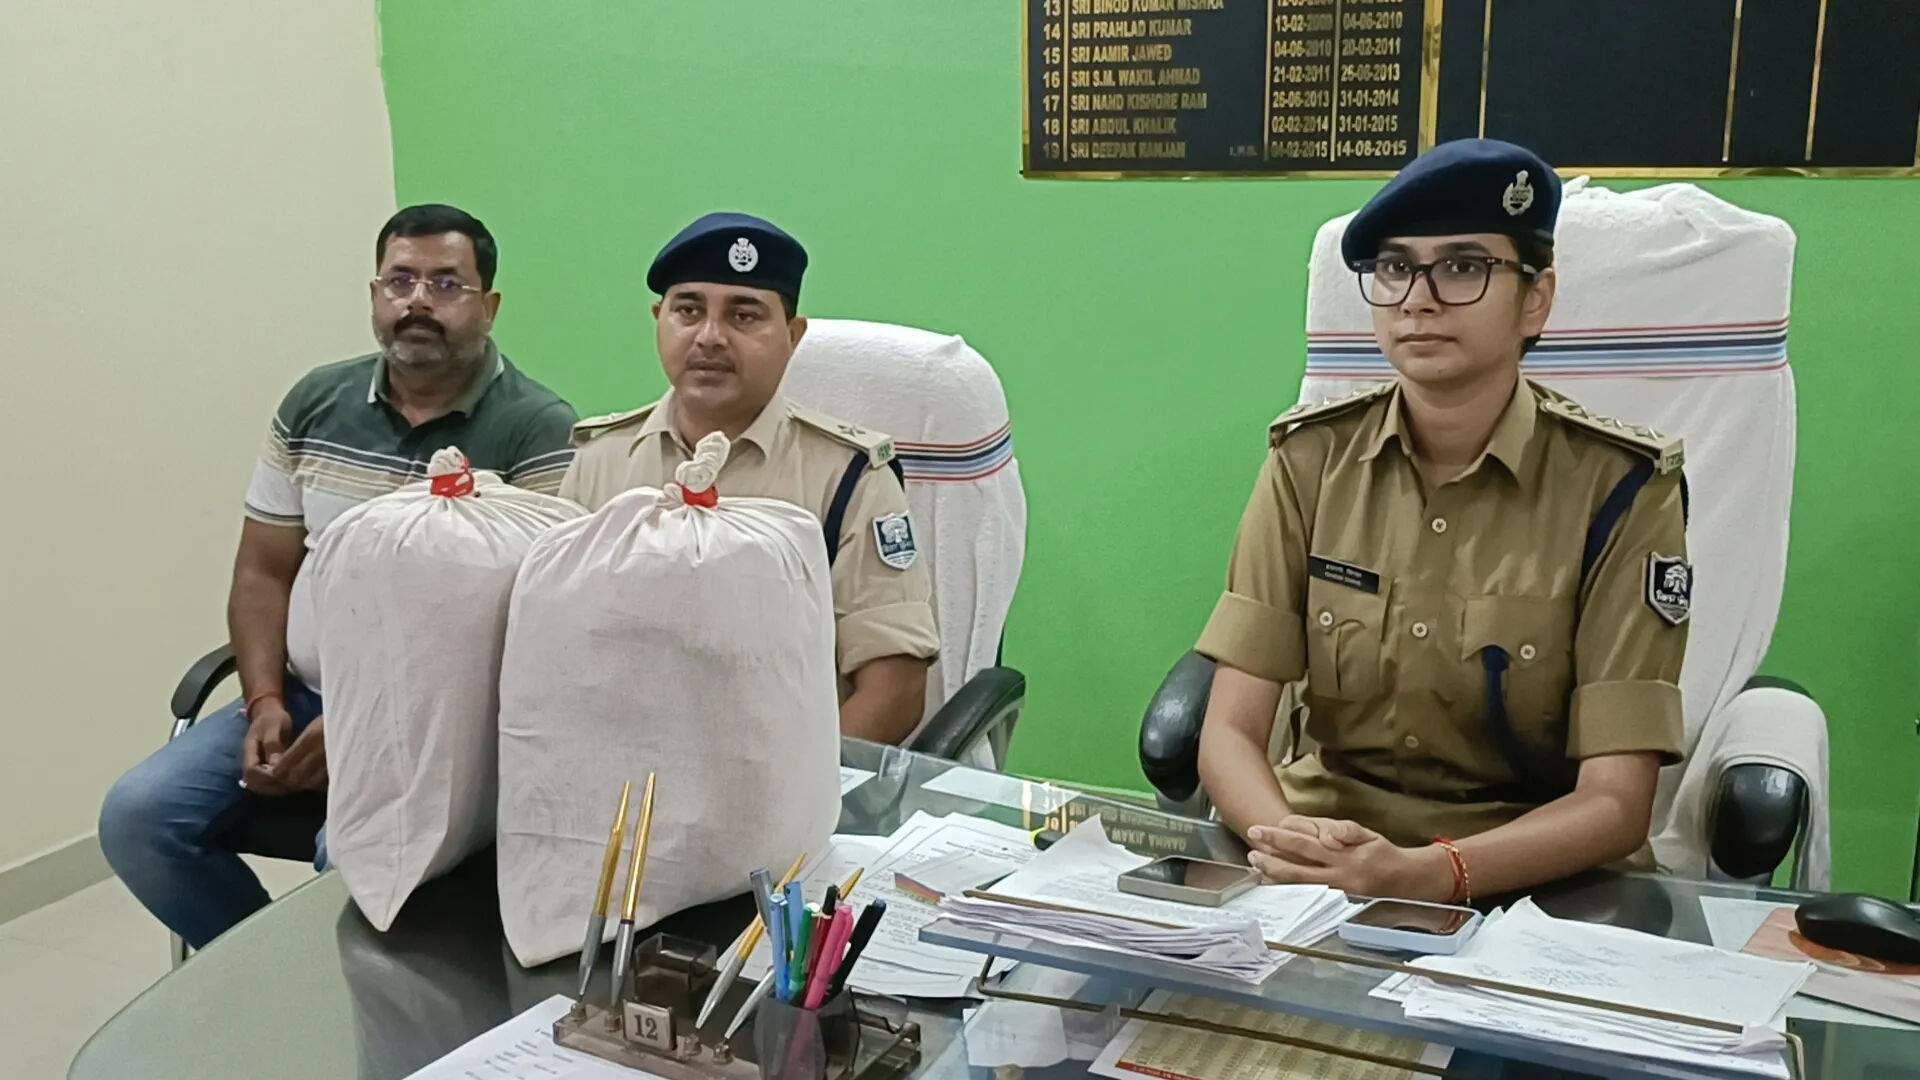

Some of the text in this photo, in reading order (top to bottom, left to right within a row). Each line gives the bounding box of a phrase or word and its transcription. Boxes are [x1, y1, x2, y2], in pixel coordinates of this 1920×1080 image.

[1043, 0, 1061, 16] 13
[1071, 0, 1090, 15] SRI
[1093, 0, 1129, 14] BINOD
[1132, 0, 1175, 13] KUMAR
[1043, 23, 1061, 40] 14
[1071, 22, 1090, 39] SRI
[1093, 20, 1146, 39] PRAHLAD
[1149, 19, 1192, 36] KUMAR
[1043, 47, 1060, 64] 15
[1071, 46, 1089, 63] SRI
[1092, 45, 1130, 63] AAMIR
[1132, 44, 1173, 62] JAWED
[1341, 37, 1401, 56] 20-02-2011
[1043, 71, 1060, 88] 16
[1071, 70, 1089, 87] SRI
[1092, 69, 1116, 87] S.M.
[1118, 68, 1156, 86] WAKIL
[1158, 68, 1201, 85] AHMAD
[1273, 64, 1330, 83] 21-02-2011
[1043, 95, 1060, 112] 17
[1071, 94, 1089, 111] SRI
[1092, 93, 1124, 111] NAND
[1127, 93, 1178, 110] KISHORE
[1181, 92, 1208, 109] RAM
[1339, 89, 1400, 107] 31-01-2014
[1043, 115, 1399, 135] 18 SRI ABDUL KHALIK 02-02-2014 31-01-2015
[1043, 142, 1060, 160] 19
[1071, 142, 1089, 159] SRI
[1092, 142, 1137, 159] DEEPAK
[1139, 141, 1186, 158] RANJAN
[1336, 139, 1408, 157] 14-08-2015
[633, 1014, 659, 1042] 12
